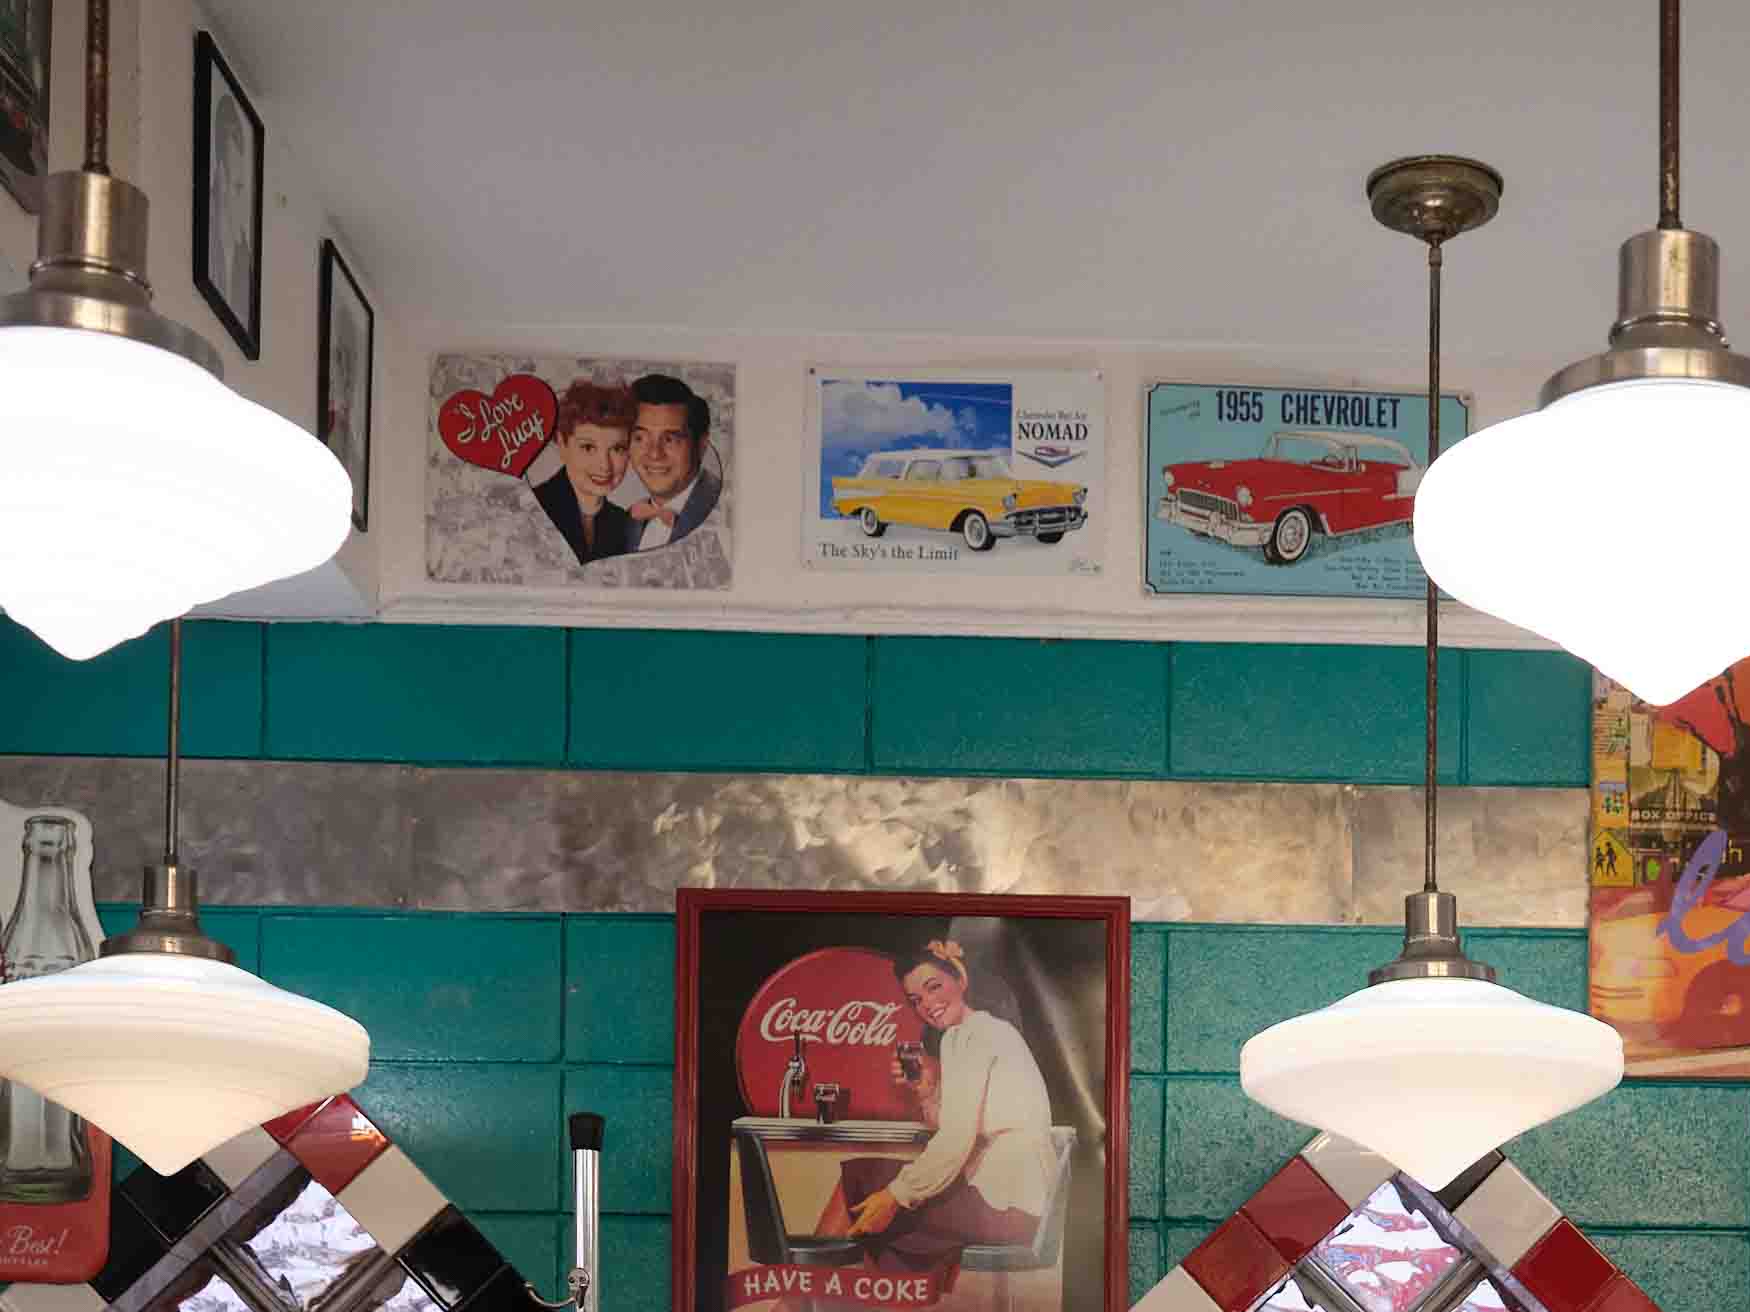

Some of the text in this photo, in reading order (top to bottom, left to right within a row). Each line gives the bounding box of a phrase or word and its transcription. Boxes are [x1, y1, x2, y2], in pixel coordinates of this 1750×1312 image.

[455, 393, 525, 443] I Love
[1215, 390, 1264, 423] 1955
[1280, 392, 1401, 430] CHEVROLET
[498, 409, 545, 468] Lucy
[1017, 422, 1089, 441] NOMAD
[818, 542, 960, 561] The Sky's the Limit
[1632, 808, 1661, 823] BOX
[760, 998, 903, 1046] Coca-Cola
[743, 1268, 930, 1302] HAVE A COKE
